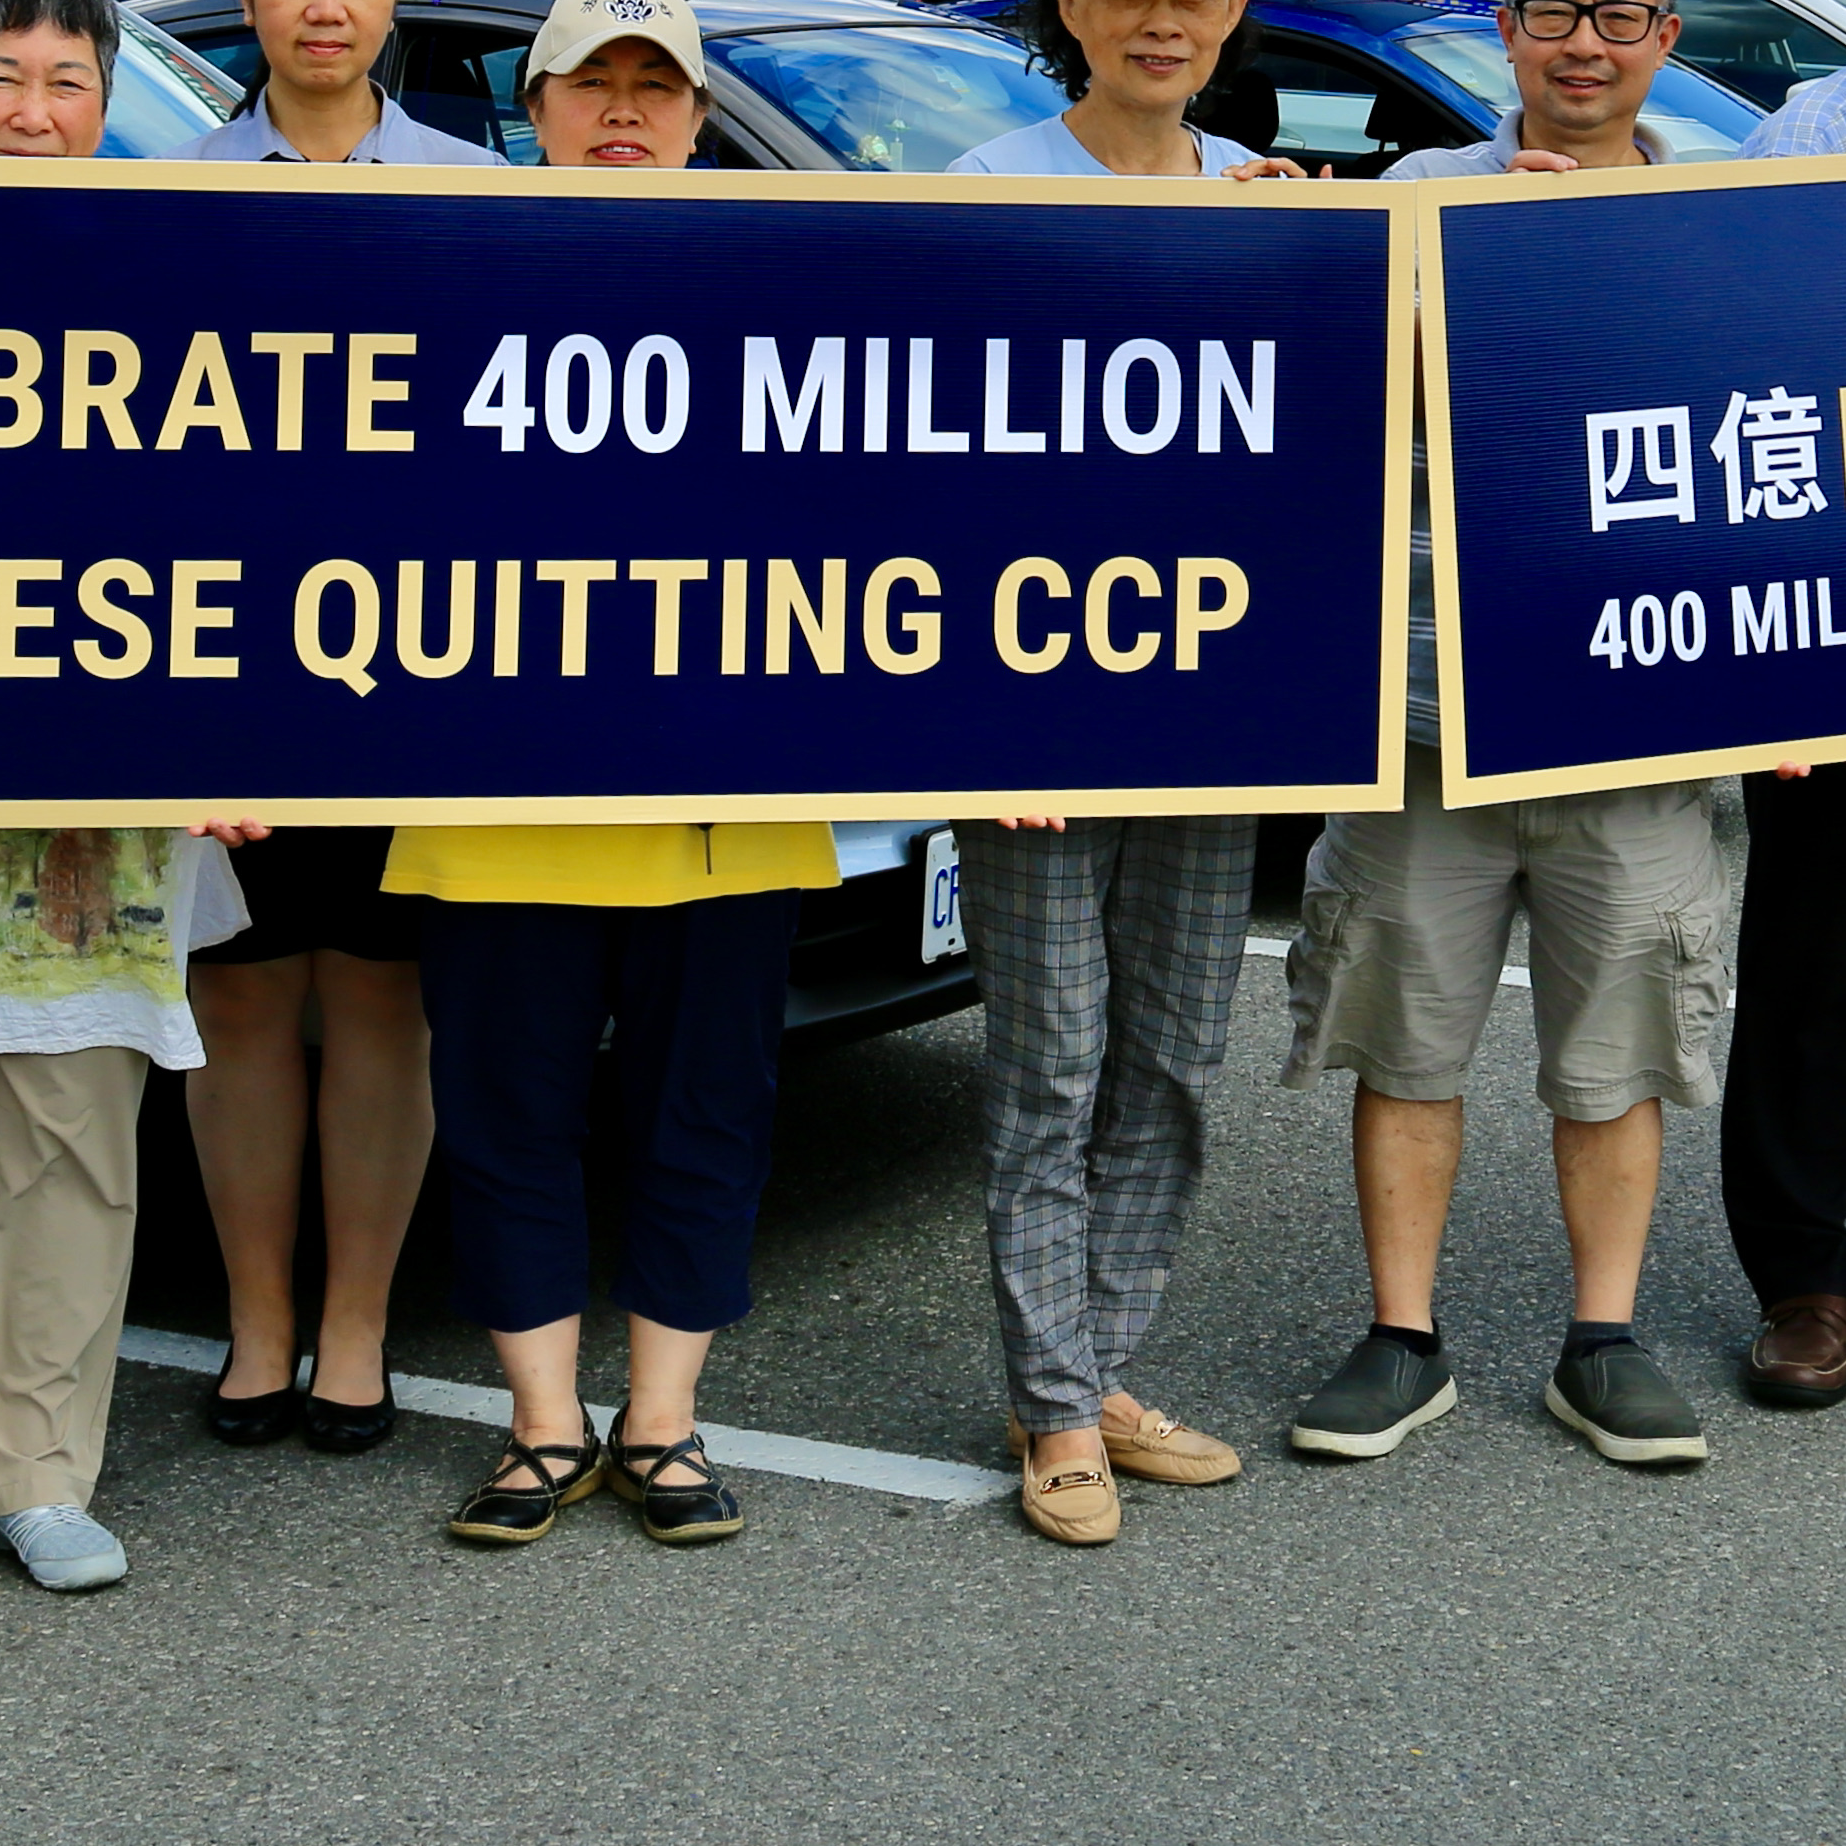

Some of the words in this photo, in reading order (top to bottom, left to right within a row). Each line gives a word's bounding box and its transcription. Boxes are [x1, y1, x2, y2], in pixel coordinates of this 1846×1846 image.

[463, 333, 690, 454] 400
[741, 335, 1277, 454] MILLION
[294, 556, 942, 697] QUITTING
[993, 555, 1250, 674] CCP
[1589, 590, 1707, 670] 400
